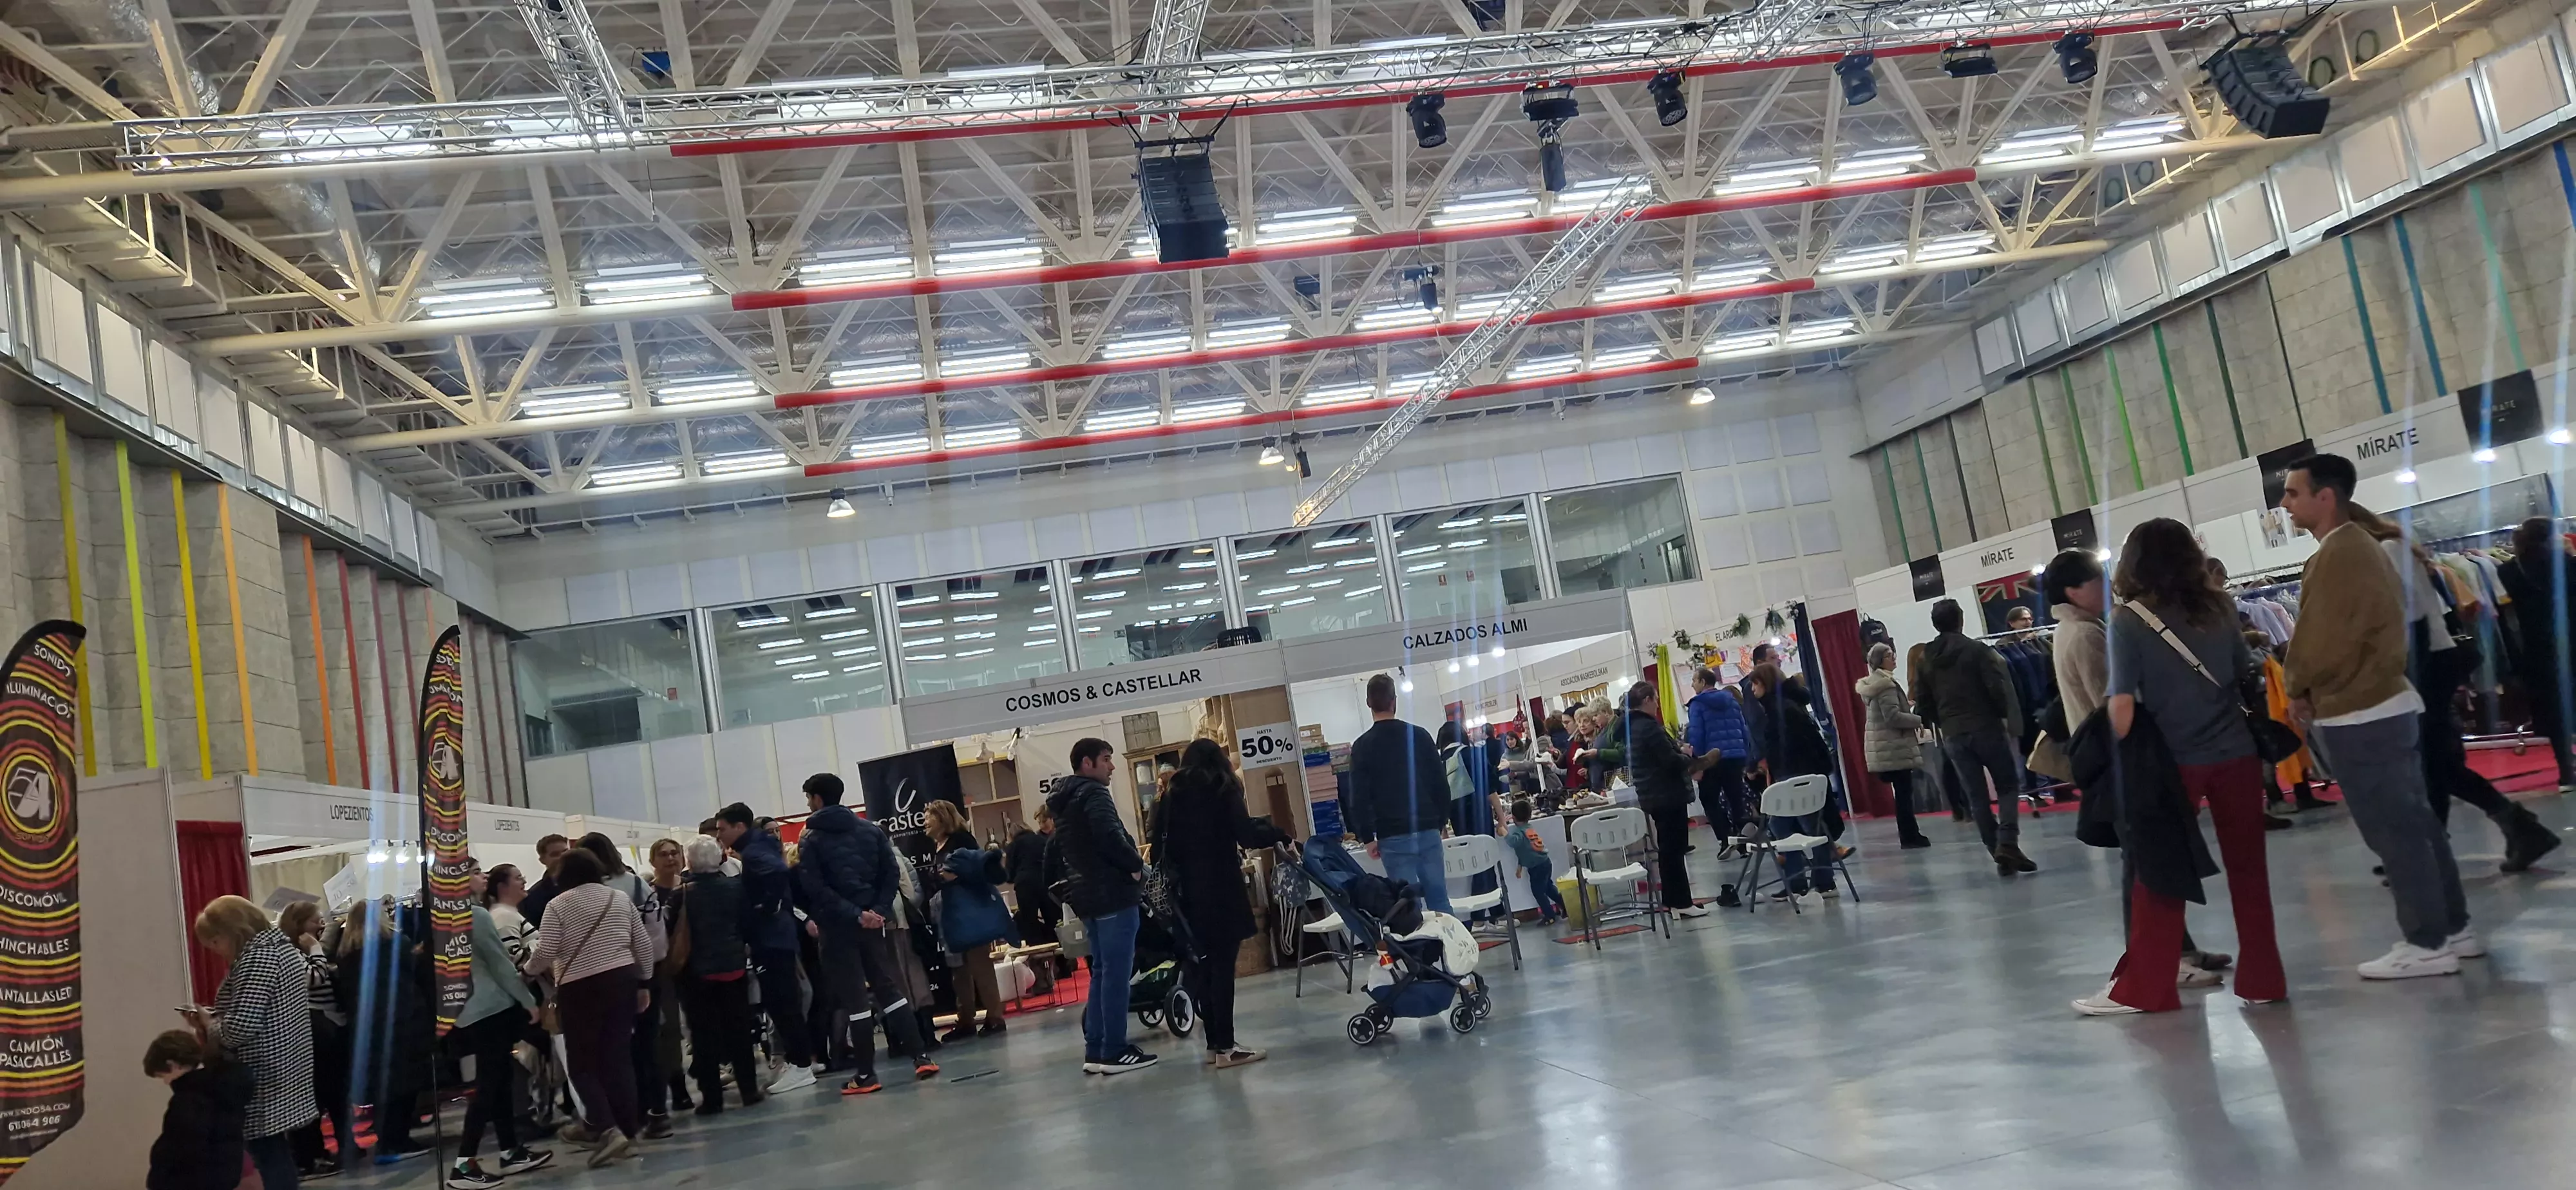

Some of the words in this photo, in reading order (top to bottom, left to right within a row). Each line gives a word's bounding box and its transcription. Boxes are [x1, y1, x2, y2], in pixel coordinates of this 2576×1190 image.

[2356, 428, 2420, 460] MÍRATE
[1980, 547, 2014, 567] MÍRATE
[1403, 625, 1488, 649] CALZADOS
[1492, 618, 1528, 636] ALMI
[1715, 633, 1723, 642] EL
[1005, 688, 1081, 712] COSMOS
[1086, 685, 1098, 700] &
[1102, 668, 1202, 697] CASTELLAR
[1242, 735, 1293, 758] 50%
[330, 804, 374, 822] LOPEZIENTOS
[9, 1035, 64, 1053] CAMIÓN
[0, 1049, 71, 1068] PASACALLES
